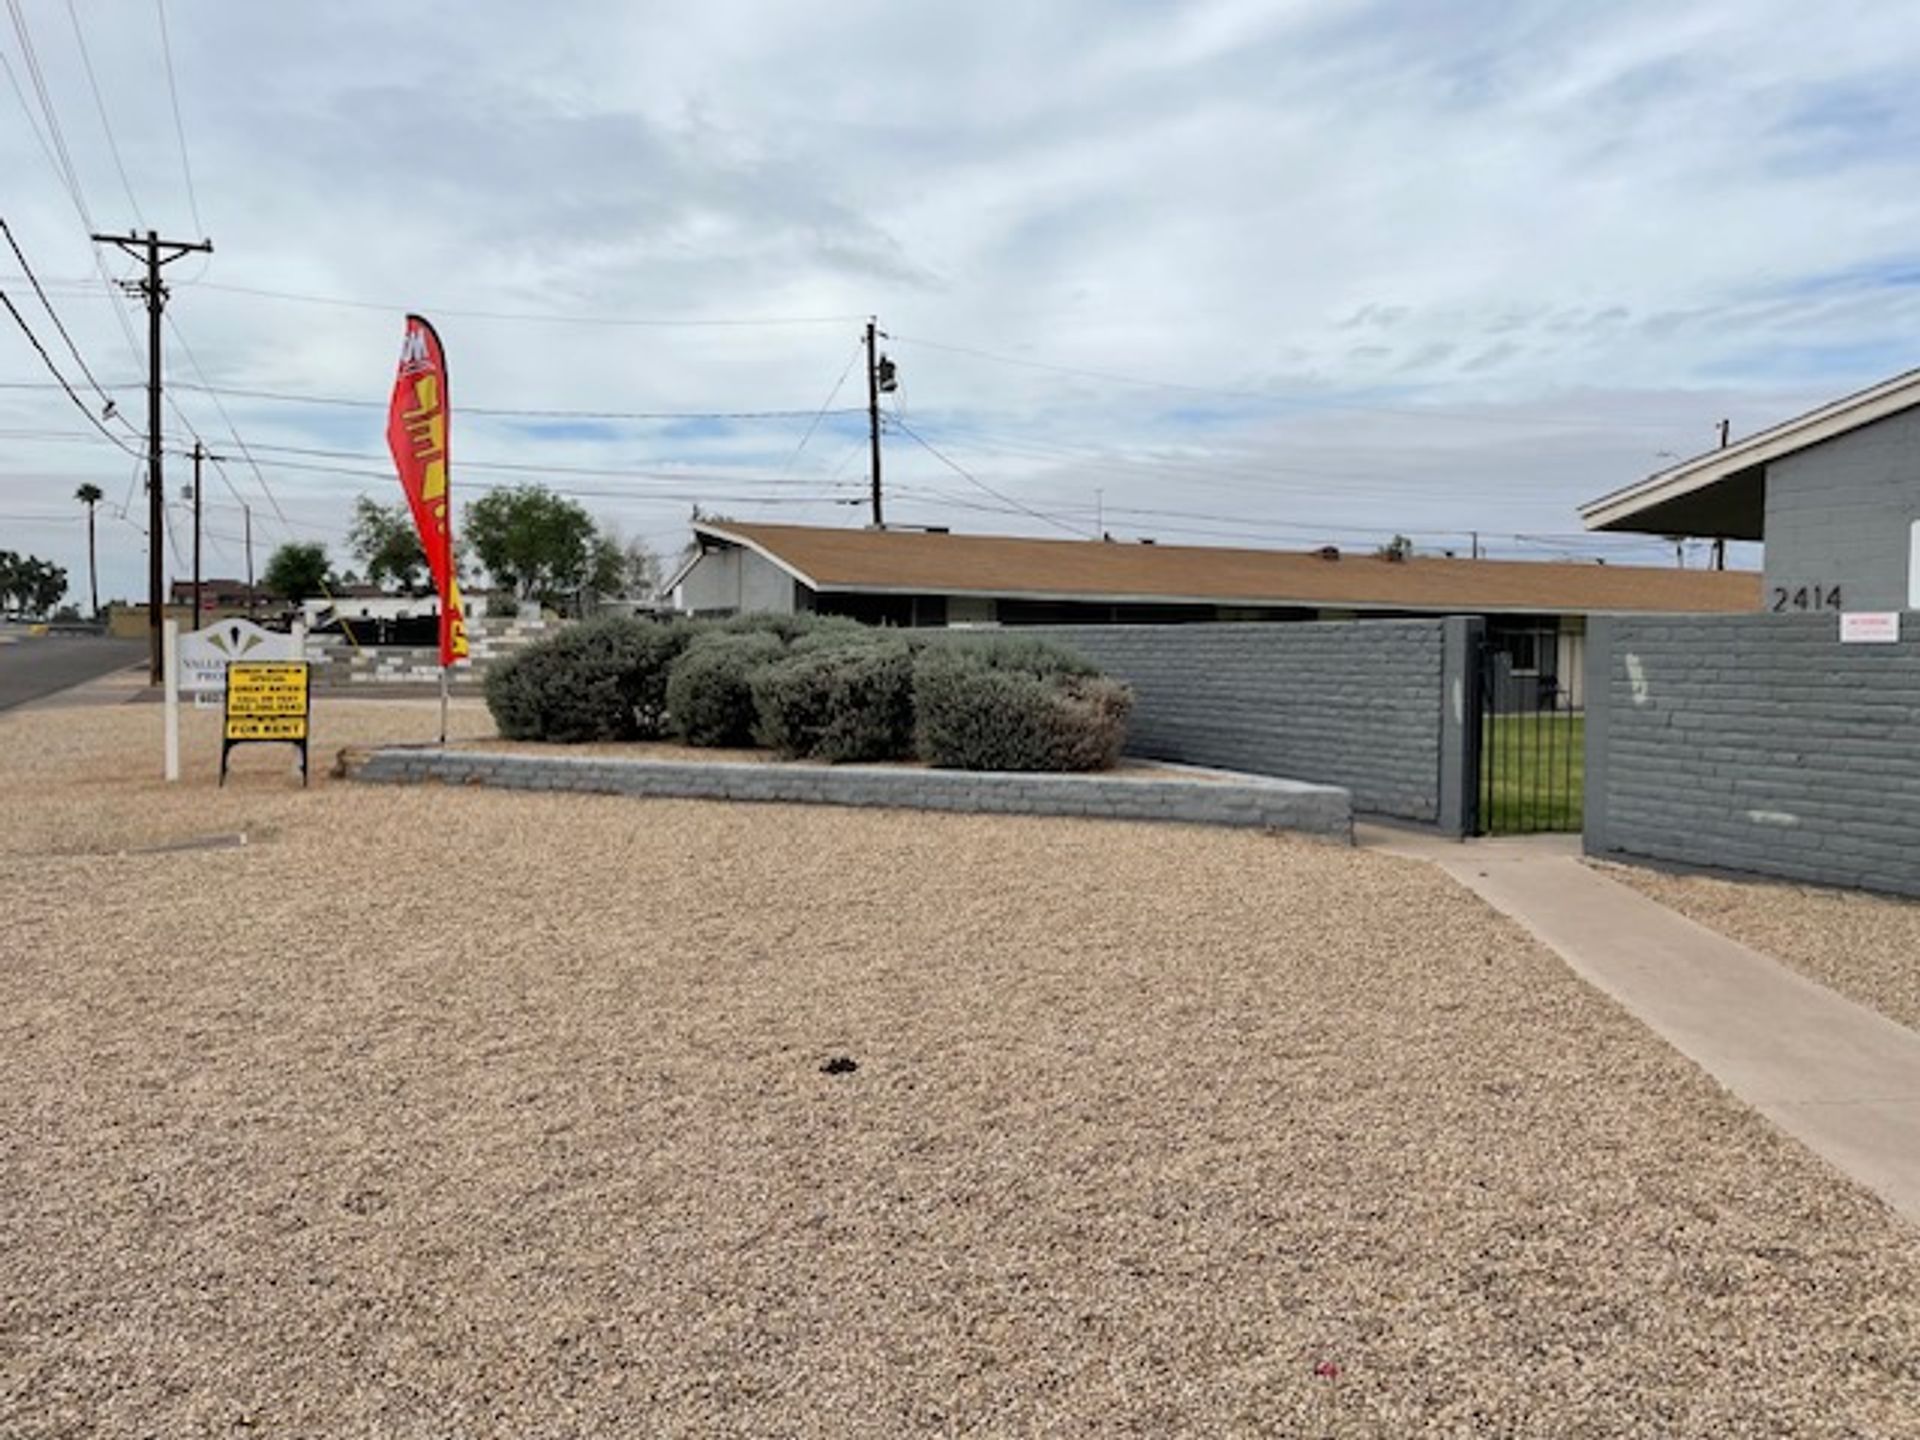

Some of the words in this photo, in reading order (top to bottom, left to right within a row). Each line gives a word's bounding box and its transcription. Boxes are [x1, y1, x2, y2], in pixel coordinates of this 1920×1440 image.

[1773, 585, 1841, 612] 2414
[231, 724, 258, 734] FOR
[263, 724, 299, 734] RENT
